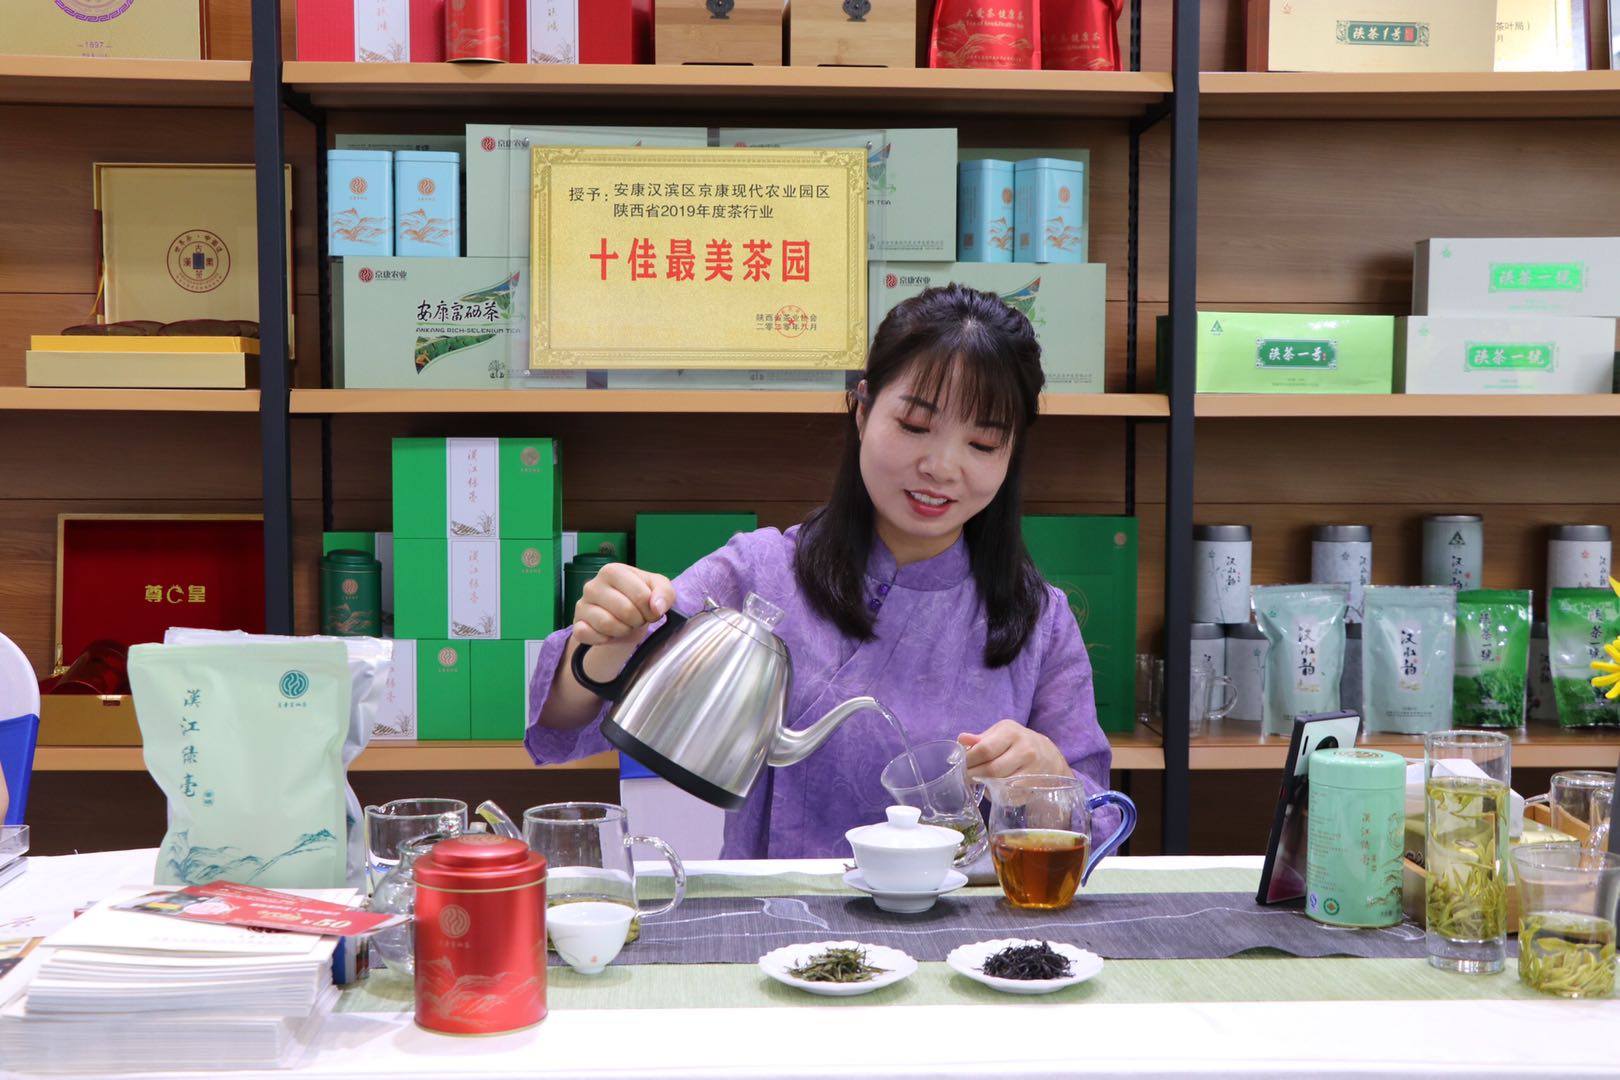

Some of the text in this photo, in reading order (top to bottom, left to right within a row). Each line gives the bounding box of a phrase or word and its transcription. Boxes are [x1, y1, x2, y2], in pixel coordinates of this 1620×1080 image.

[568, 182, 830, 202] 授予： 安康汉滨区京康现代农业园区
[613, 203, 774, 219] 陕西省2019年度茶行业
[589, 237, 811, 283] 十佳最美茶园
